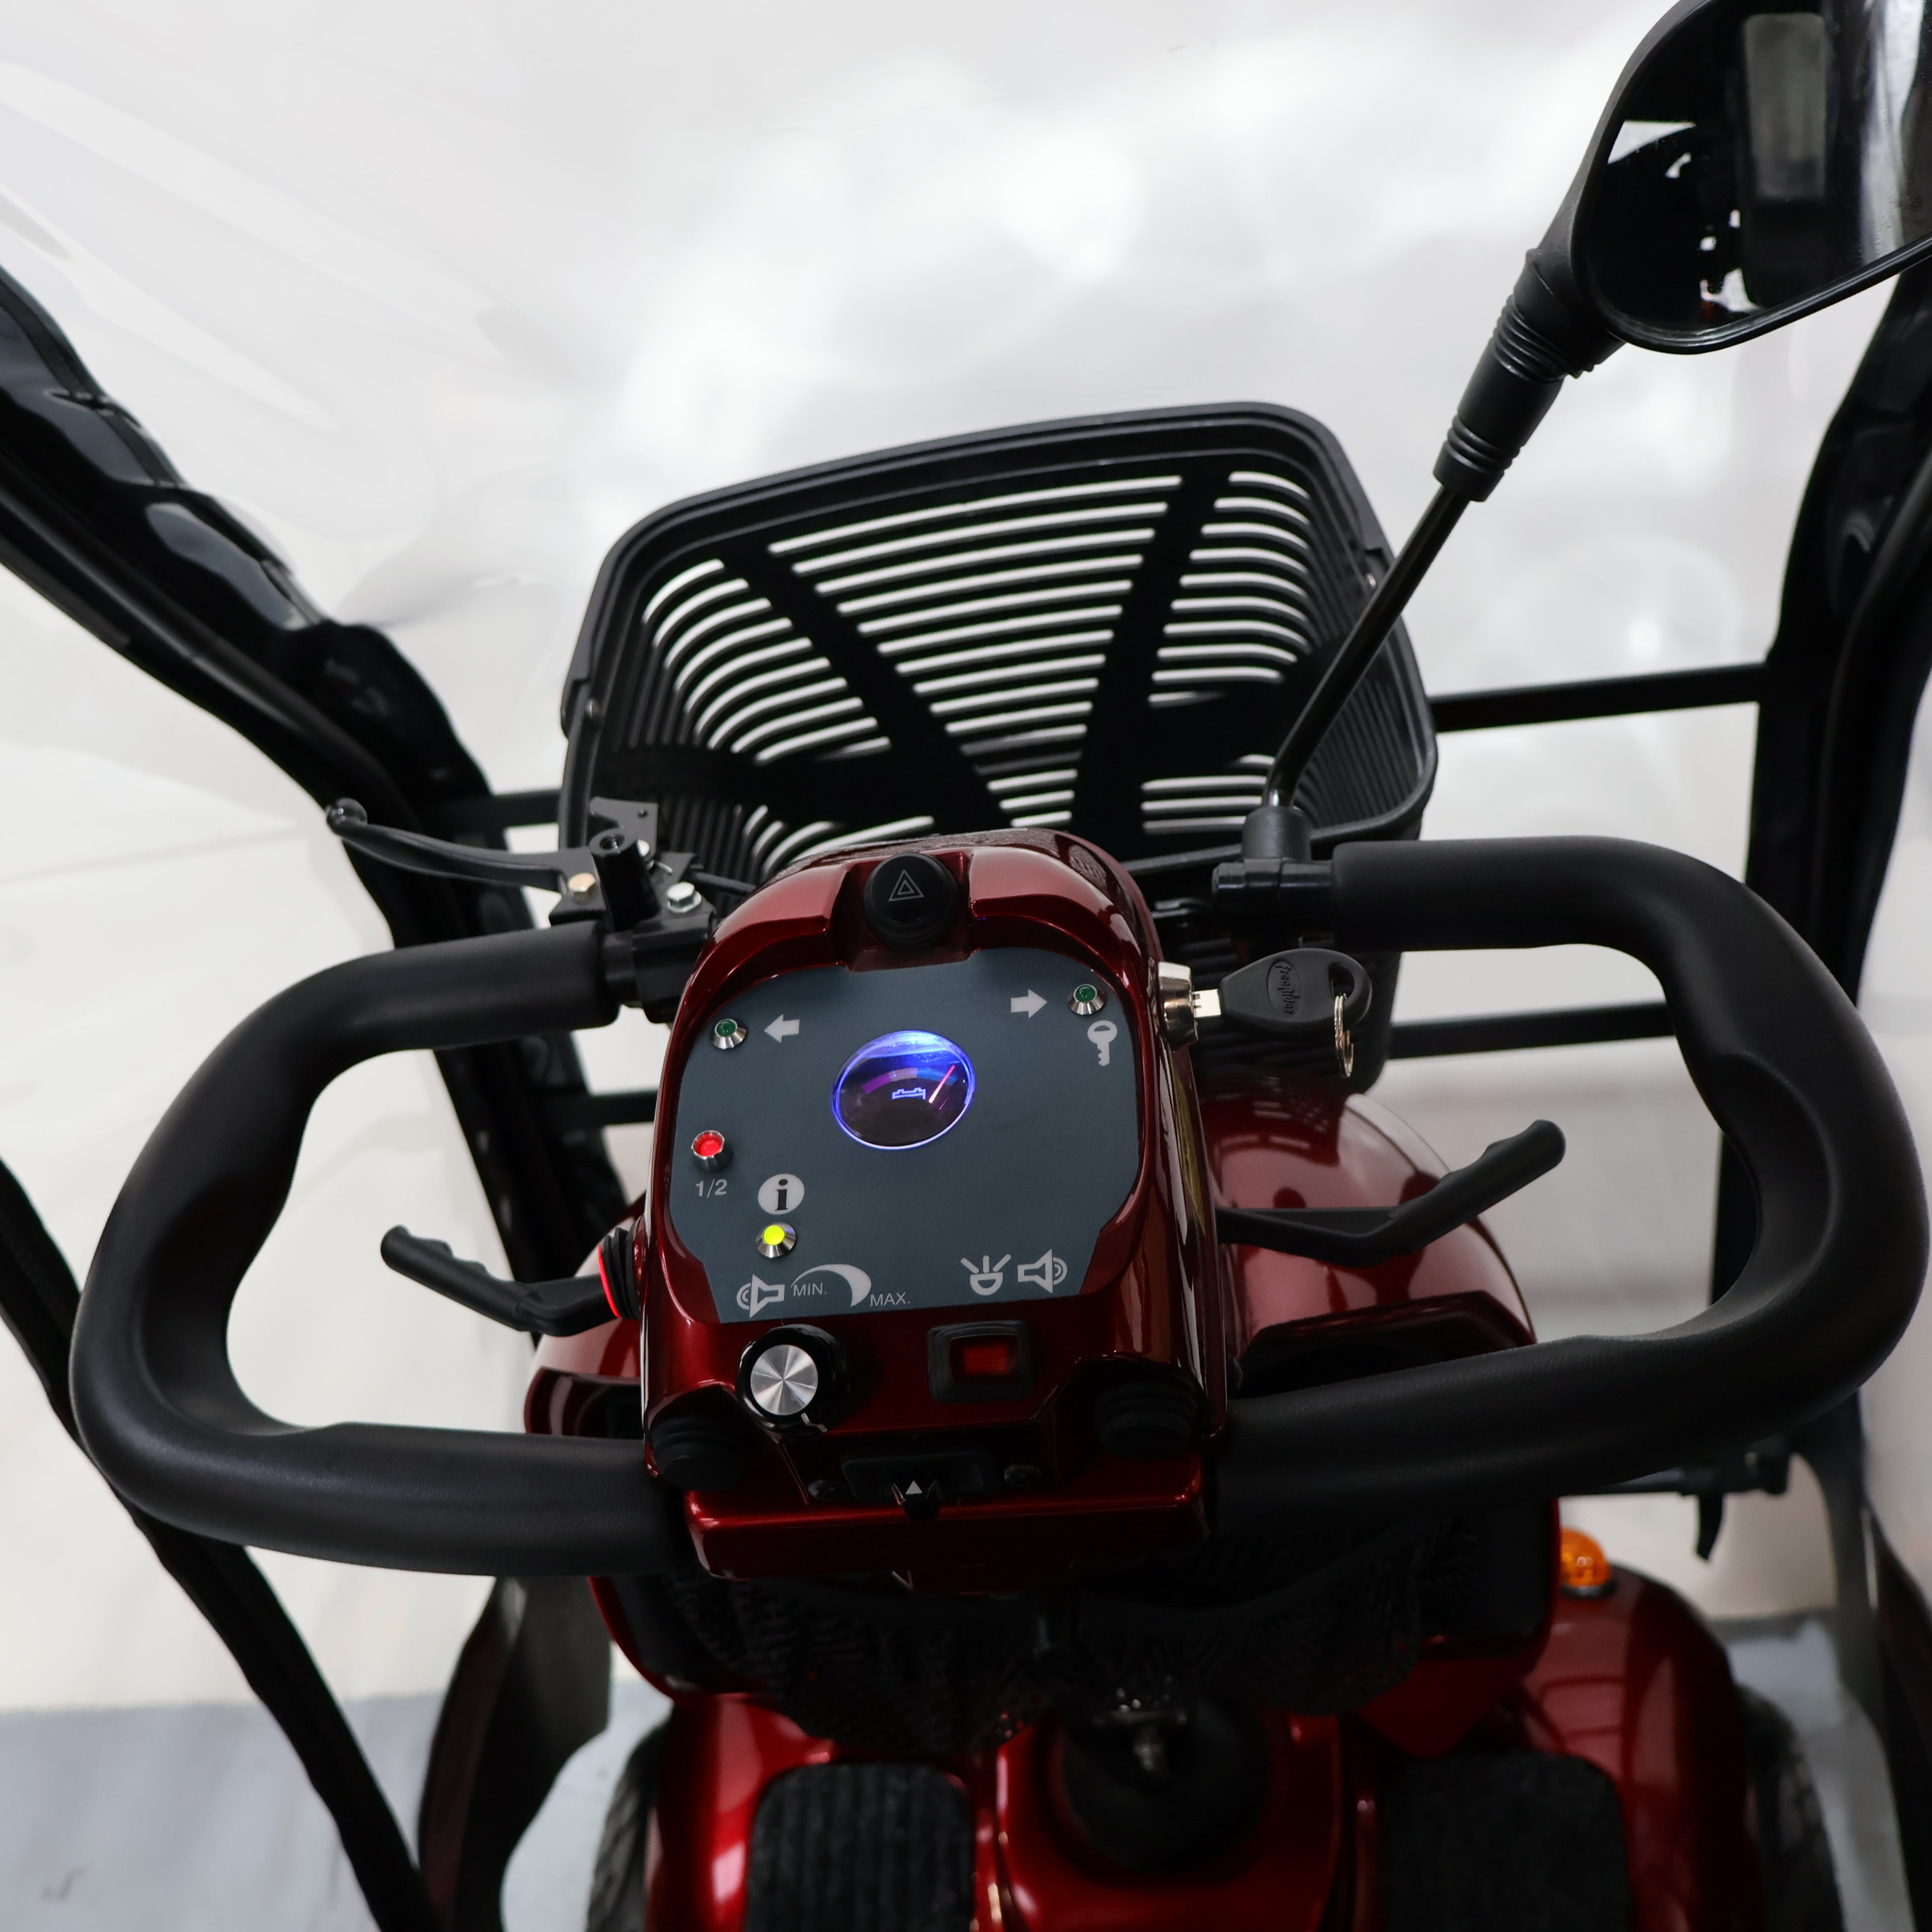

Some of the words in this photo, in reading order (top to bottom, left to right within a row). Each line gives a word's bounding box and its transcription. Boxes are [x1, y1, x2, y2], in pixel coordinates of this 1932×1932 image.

[696, 1179, 728, 1198] 1/2
[793, 1282, 827, 1297] MIN.
[870, 1292, 911, 1307] MAX.
